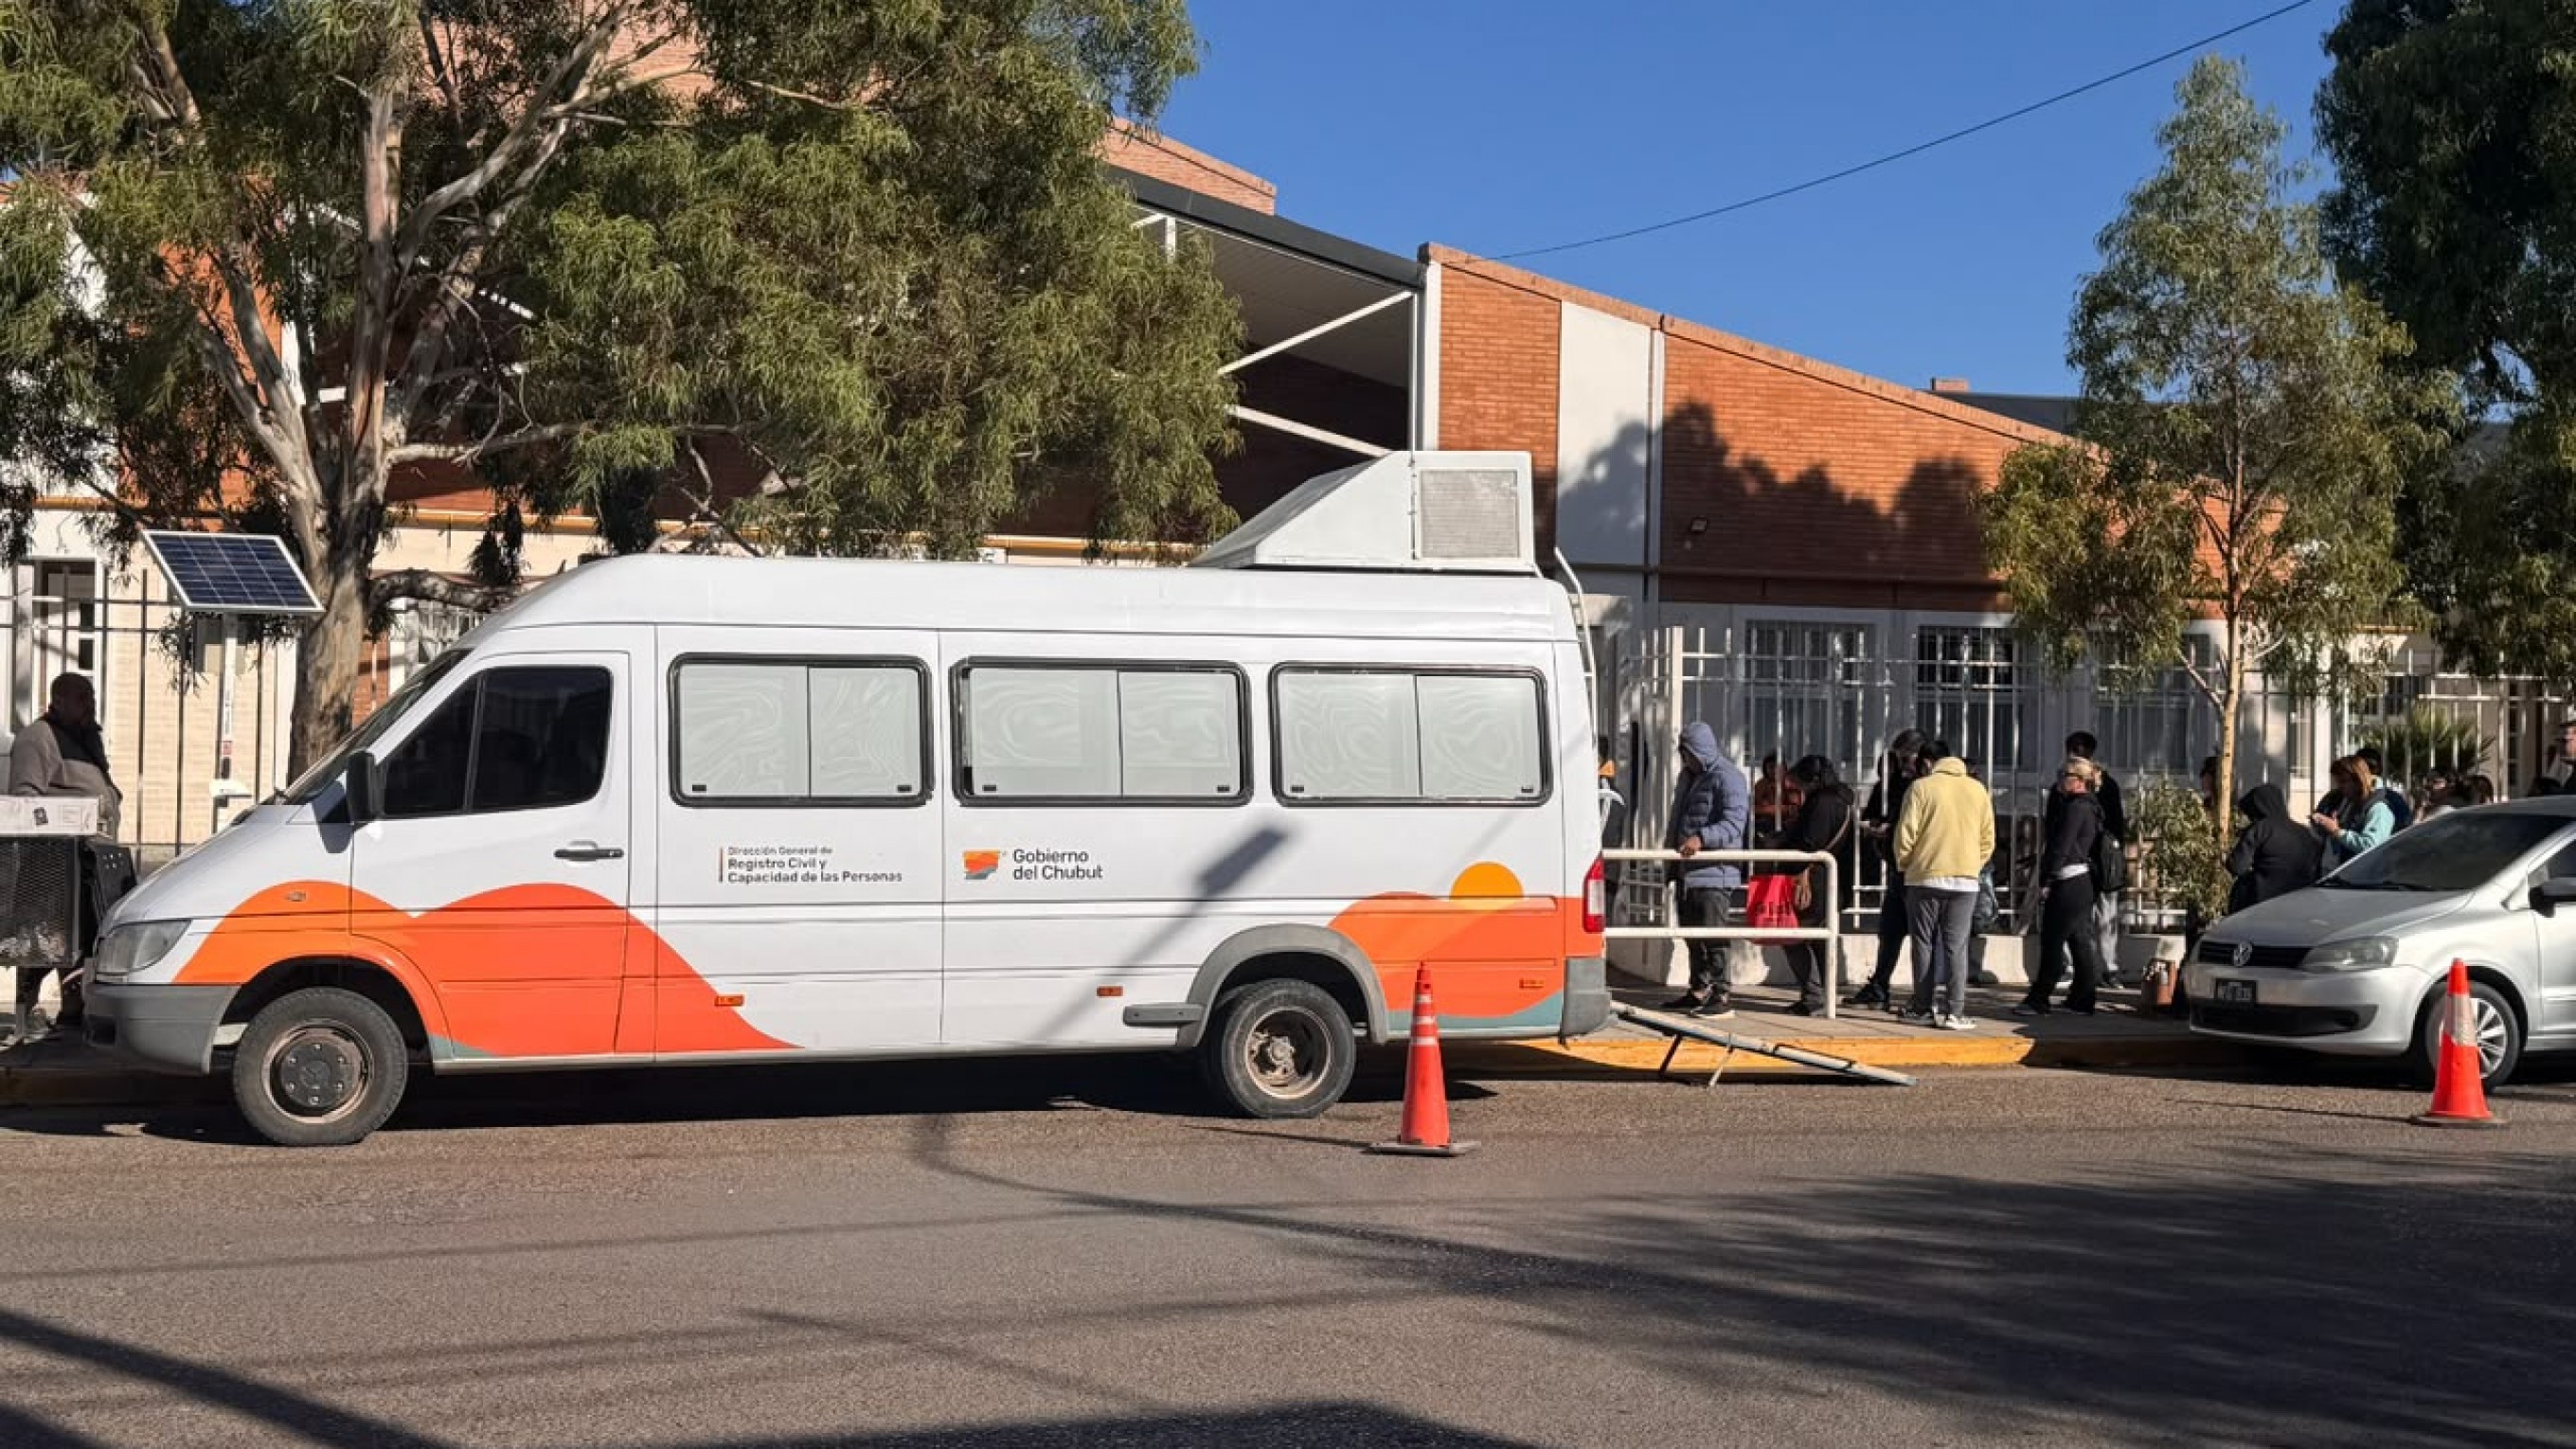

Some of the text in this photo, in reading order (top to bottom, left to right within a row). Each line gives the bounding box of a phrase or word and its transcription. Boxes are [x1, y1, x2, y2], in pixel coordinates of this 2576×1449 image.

[778, 846, 817, 855] General
[820, 846, 832, 854] de
[1012, 848, 1089, 864] Gobierno
[727, 857, 828, 872] Registro Civil y
[727, 870, 903, 885] Capacidad de las Personas
[1012, 864, 1103, 881] del Chubut
